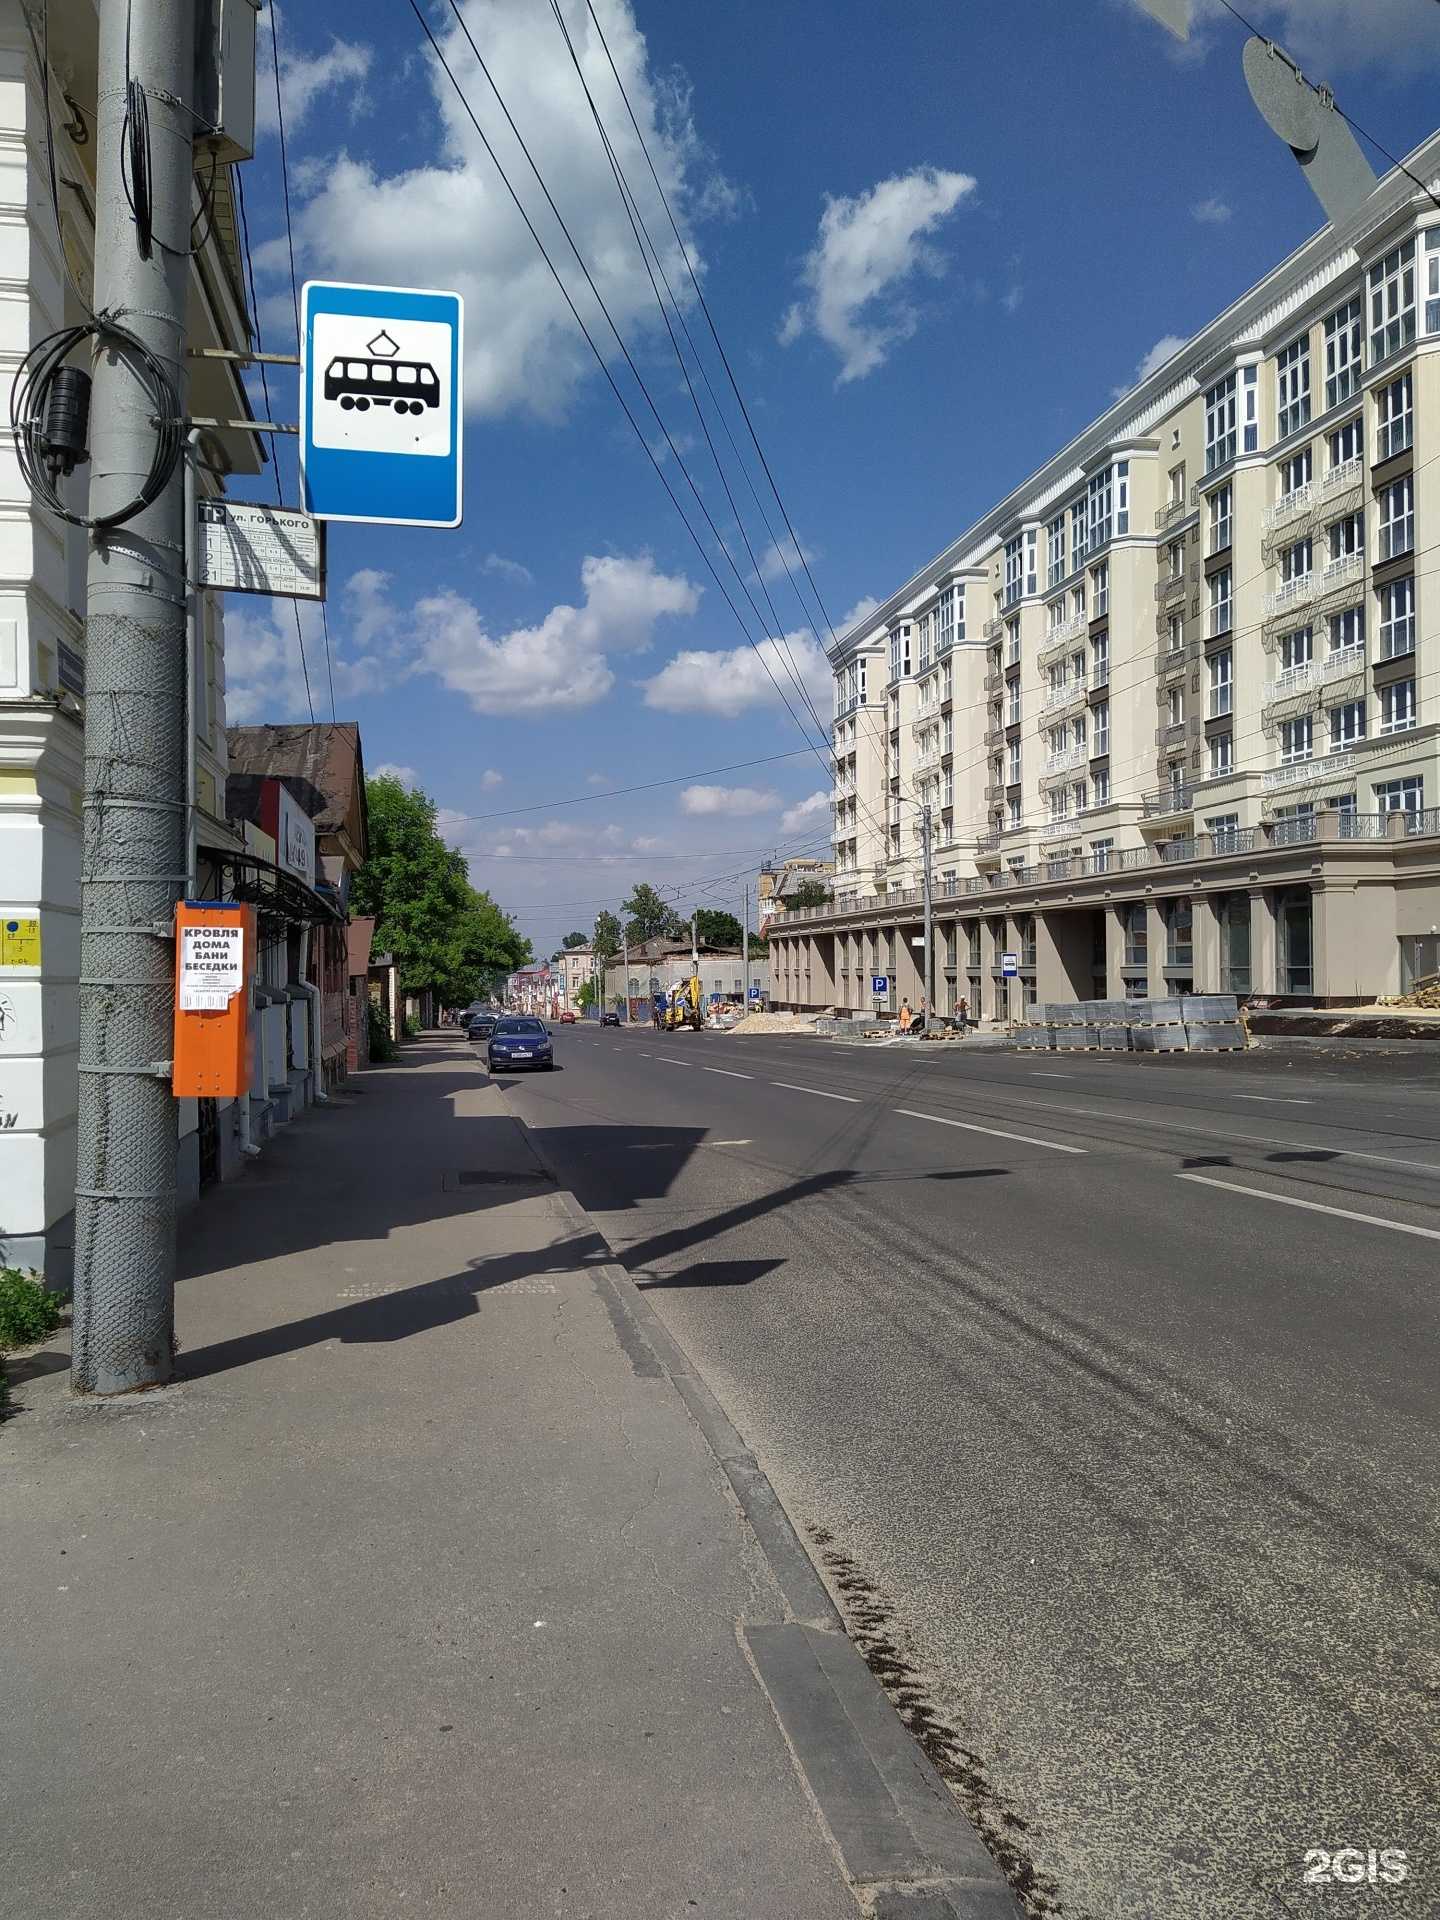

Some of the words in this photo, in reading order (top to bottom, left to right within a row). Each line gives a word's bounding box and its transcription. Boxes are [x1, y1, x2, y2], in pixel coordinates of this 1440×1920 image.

[250, 515, 310, 529] ГОРЬКОГО
[202, 569, 217, 581] 21
[184, 928, 239, 938] КРОВЛЯ
[192, 940, 231, 950] ДОМА
[194, 951, 228, 960] БАНИ
[184, 962, 238, 972] БЕСЕДКИ
